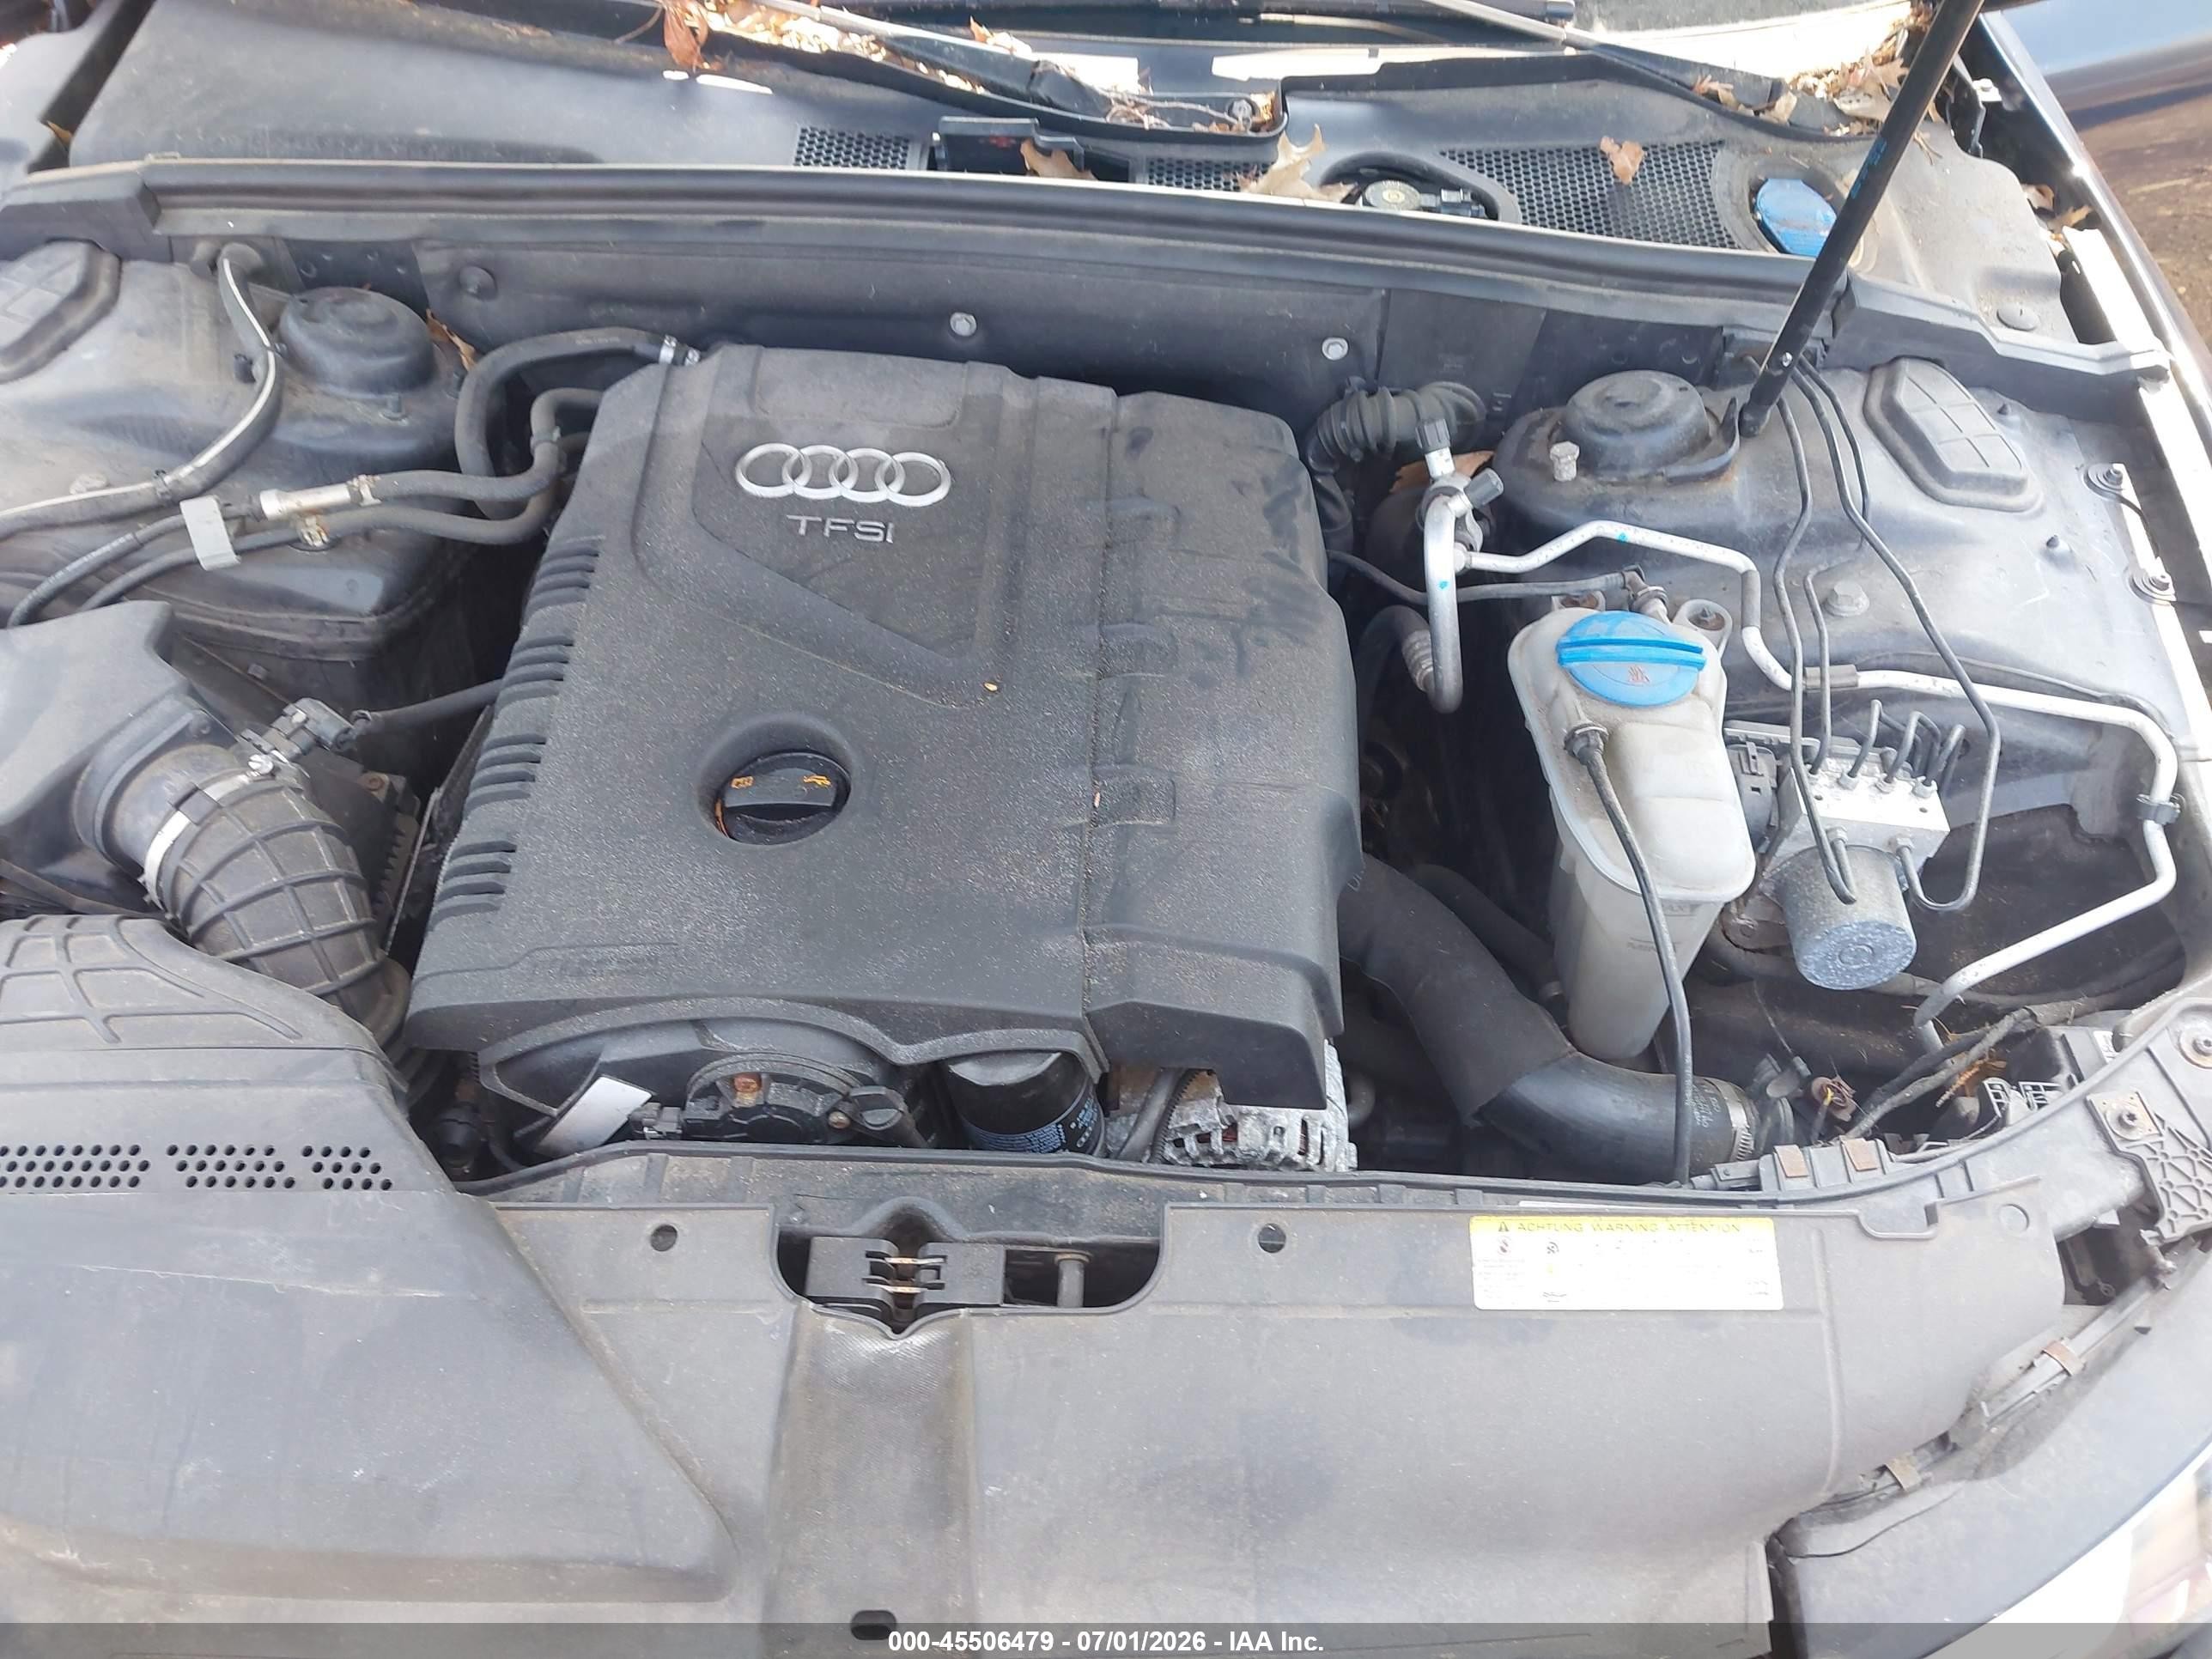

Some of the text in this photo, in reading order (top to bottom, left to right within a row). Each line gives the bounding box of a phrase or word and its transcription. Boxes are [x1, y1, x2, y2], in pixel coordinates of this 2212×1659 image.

[786, 514, 894, 544] TFSI
[1517, 1222, 1583, 1233] ACHTUNG
[1591, 1223, 1659, 1233] WARNING
